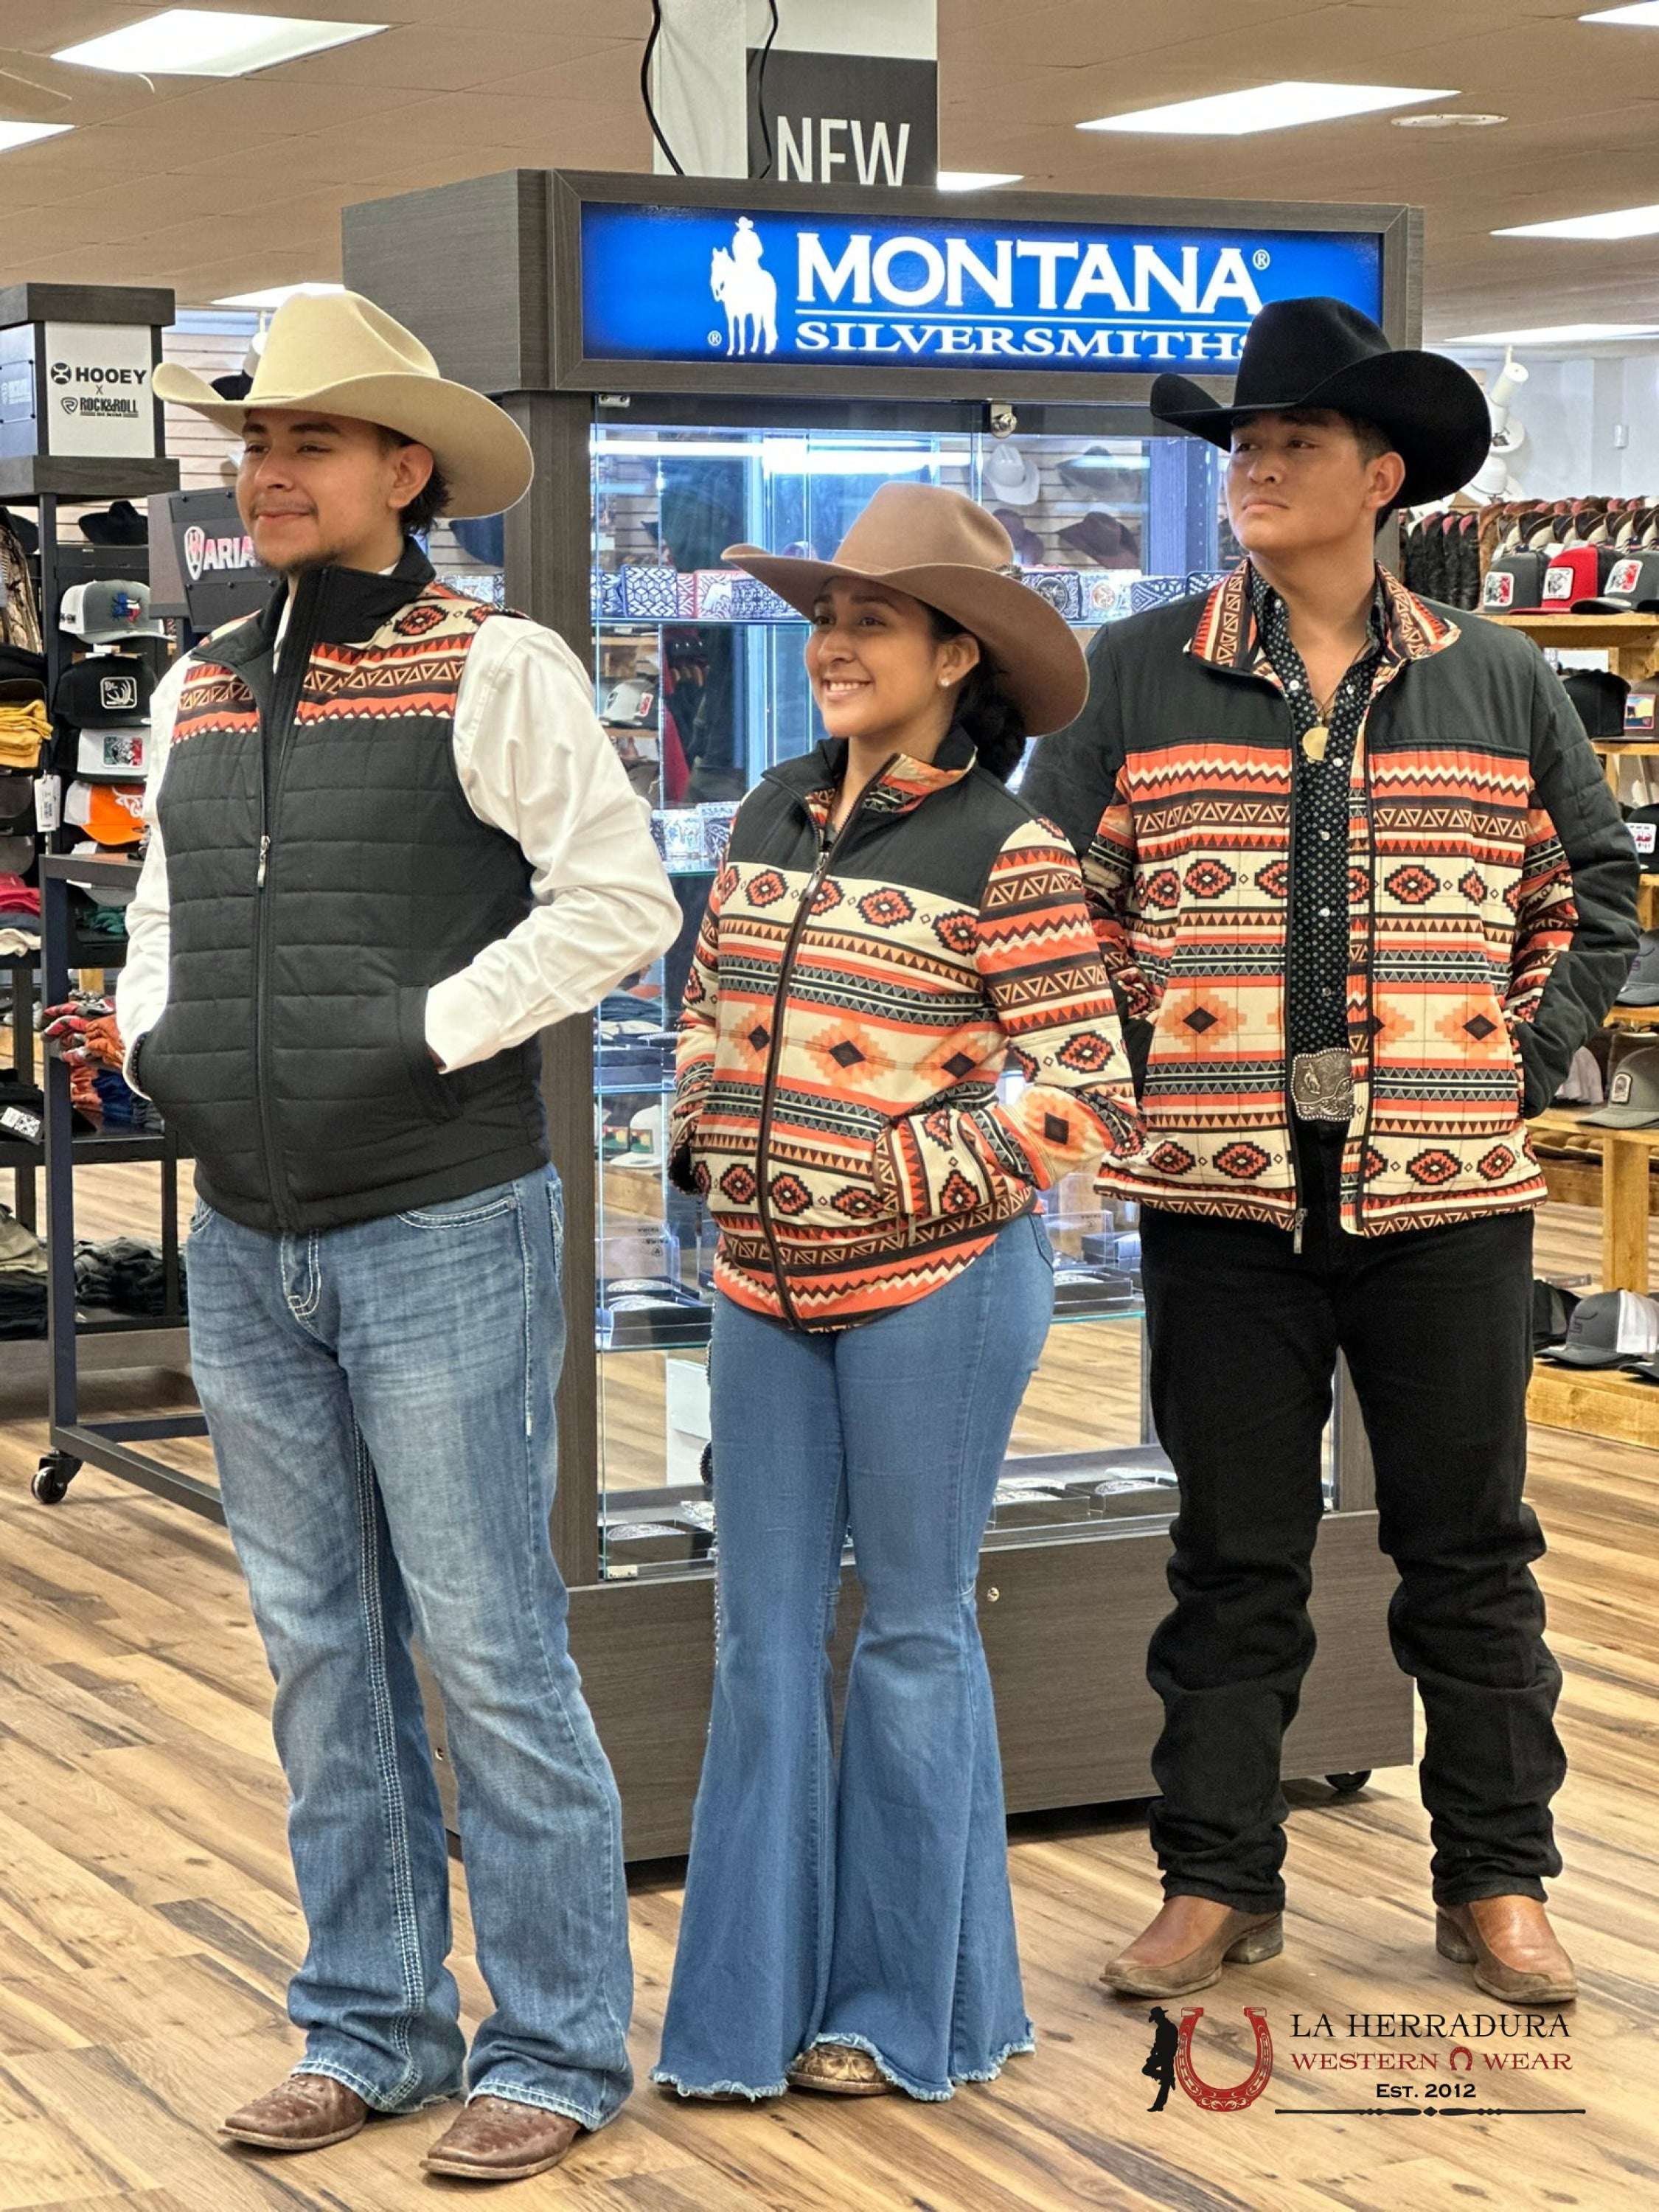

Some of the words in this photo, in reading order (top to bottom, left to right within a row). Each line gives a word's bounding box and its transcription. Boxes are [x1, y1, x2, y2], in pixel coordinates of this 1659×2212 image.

[795, 321, 1248, 360] SILVERSMITH
[75, 366, 147, 385] HOOEY
[203, 535, 260, 571] ARIA
